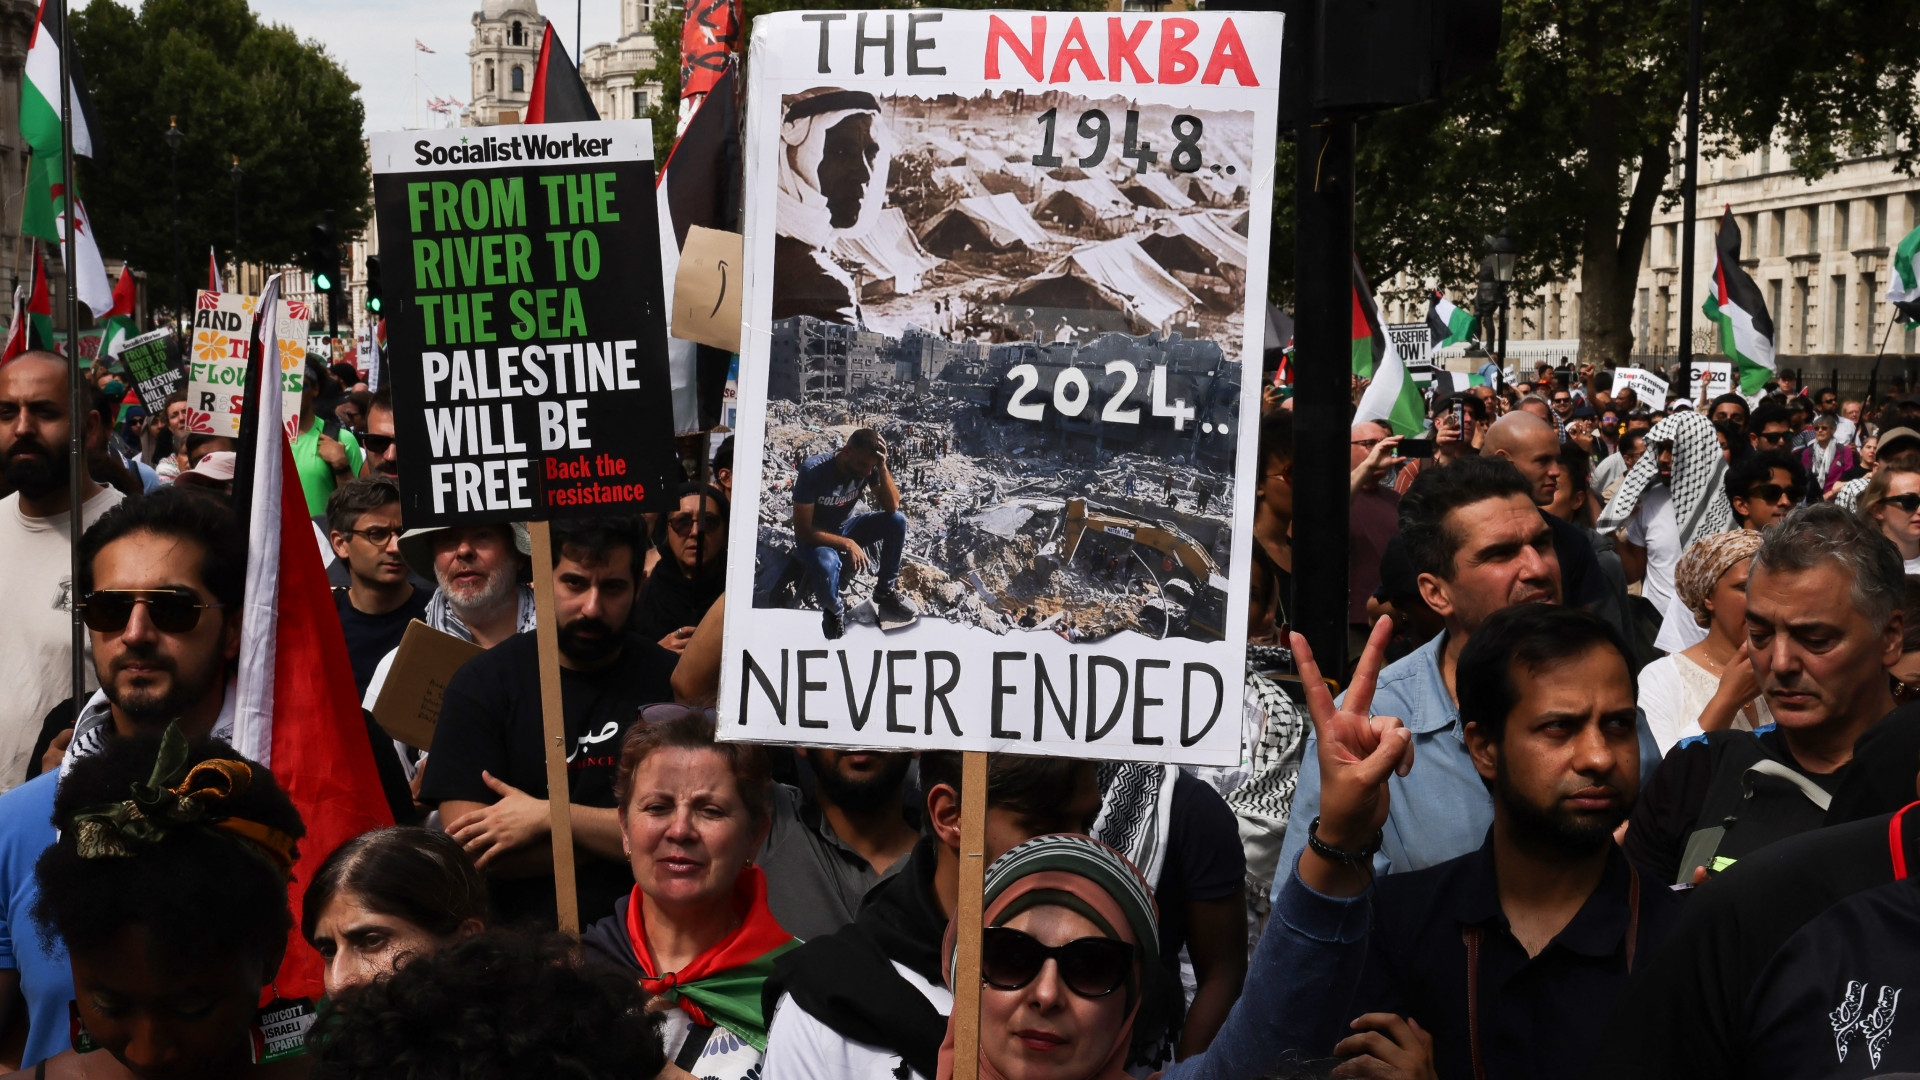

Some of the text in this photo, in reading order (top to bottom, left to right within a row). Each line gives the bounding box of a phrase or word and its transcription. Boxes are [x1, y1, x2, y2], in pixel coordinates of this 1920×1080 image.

[801, 12, 1260, 87] THE NAKBA
[407, 172, 620, 232] FROM THE
[412, 229, 600, 289] RIVER TO
[195, 309, 242, 332] AND
[415, 288, 588, 345] THE SEA
[1389, 330, 1429, 344] EASEFIRE
[124, 338, 167, 360] FROM THE
[128, 350, 167, 373] RIVER TO
[132, 362, 169, 383] THE SEA
[422, 340, 641, 402] PALESTINE
[138, 368, 182, 393] PALESTINE
[1627, 380, 1656, 396] Israel
[1639, 374, 1666, 394] Arming
[142, 382, 177, 404] WILL BE
[424, 399, 591, 458] WILL BE
[545, 453, 627, 480] Back the
[430, 458, 532, 514] FREE
[547, 483, 645, 506] resistance
[738, 648, 1224, 748] NEVER ENDED
[262, 1004, 303, 1025] BOYCOTT
[265, 1021, 301, 1039] ISRAELI
